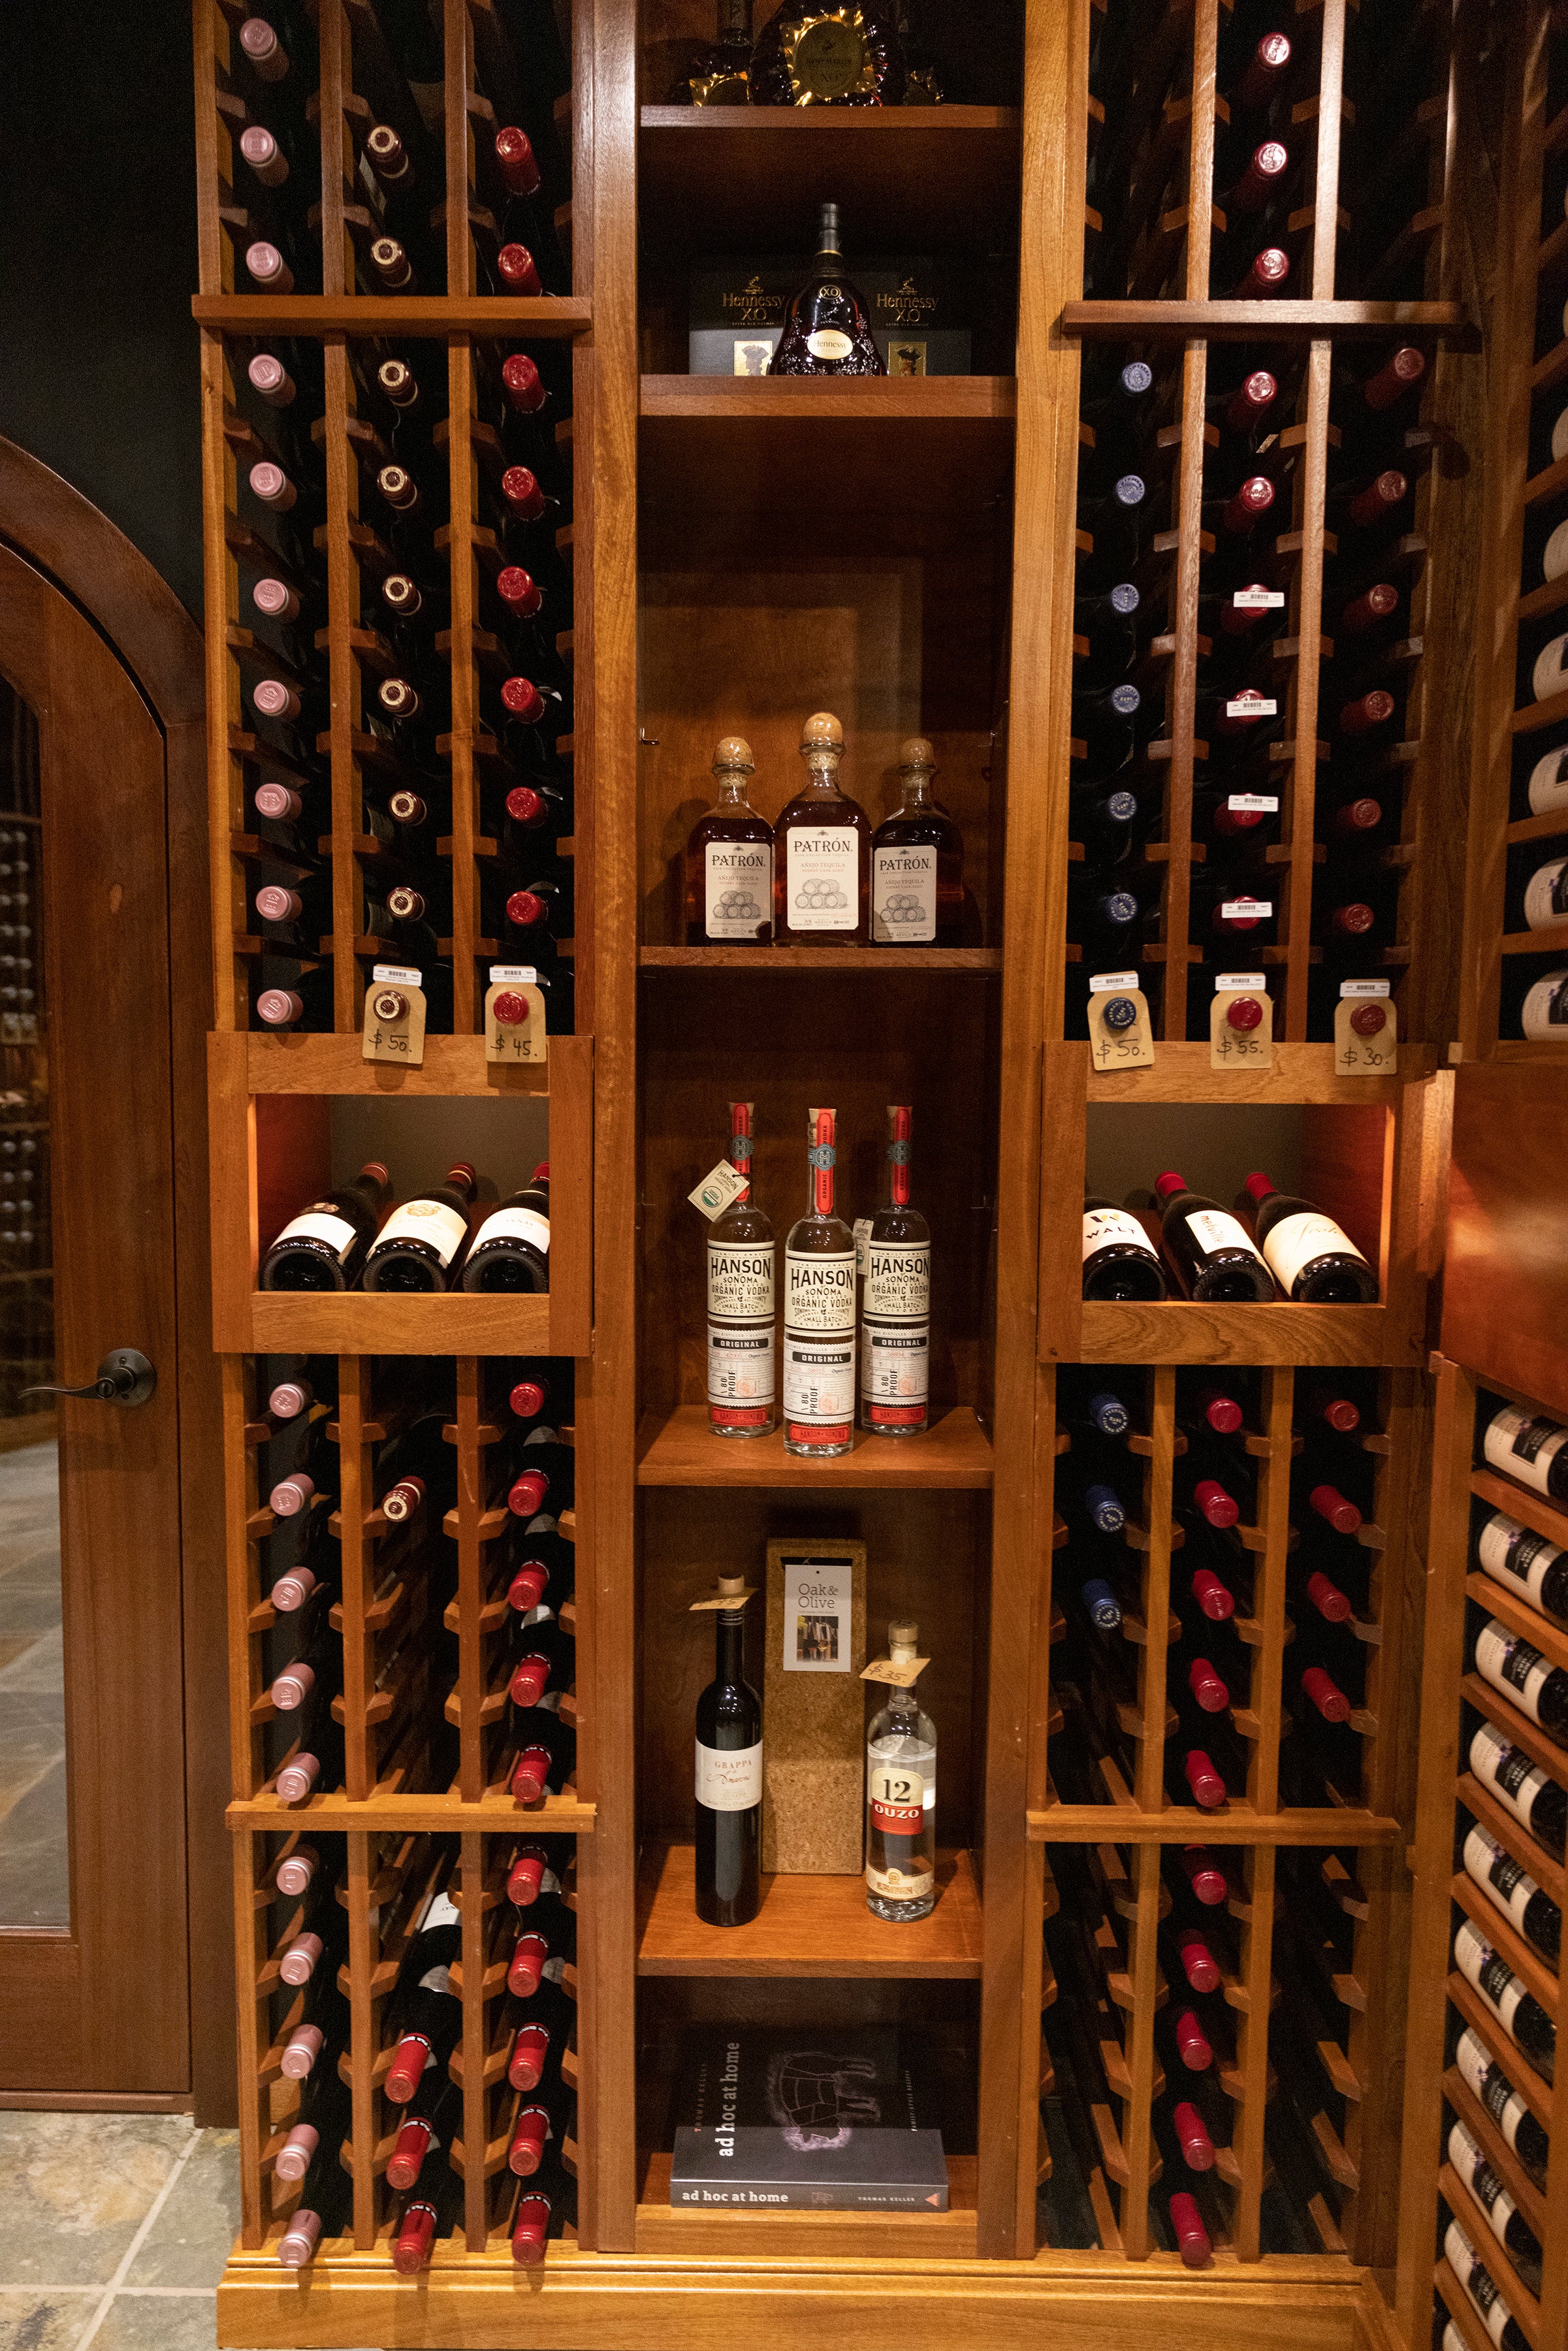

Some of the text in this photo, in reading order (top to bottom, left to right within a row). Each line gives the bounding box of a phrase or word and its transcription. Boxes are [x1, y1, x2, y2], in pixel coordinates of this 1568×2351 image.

[722, 293, 785, 309] Hennessy
[876, 293, 939, 311] Hennessy
[814, 339, 847, 349] Hennessy
[794, 837, 850, 852] PATRÓN
[712, 853, 764, 867] PATRÓN
[880, 856, 930, 871] PATRÓN
[820, 1151, 830, 1164] H
[718, 1170, 739, 1191] HANSON
[1085, 1226, 1136, 1239] WALT
[1200, 1215, 1225, 1243] melville
[711, 1257, 771, 1280] HANSON
[871, 1257, 930, 1279] HANSON
[791, 1268, 854, 1291] HANSON
[712, 1285, 769, 1296] ORGANIC VODKA
[871, 1285, 929, 1294] ORGANIC VODKA
[792, 1297, 852, 1308] ORGANIC VODKA
[721, 1377, 728, 1388] 80
[882, 1377, 889, 1386] 80
[801, 1394, 808, 1404] 80
[798, 1596, 835, 1608] Olive
[714, 1759, 752, 1769] GRAPPA
[883, 1779, 910, 1802] 12
[874, 1804, 920, 1819] OUZO
[714, 2042, 741, 2157] ad hoc at home
[682, 2190, 789, 2203] ad hoc at home
